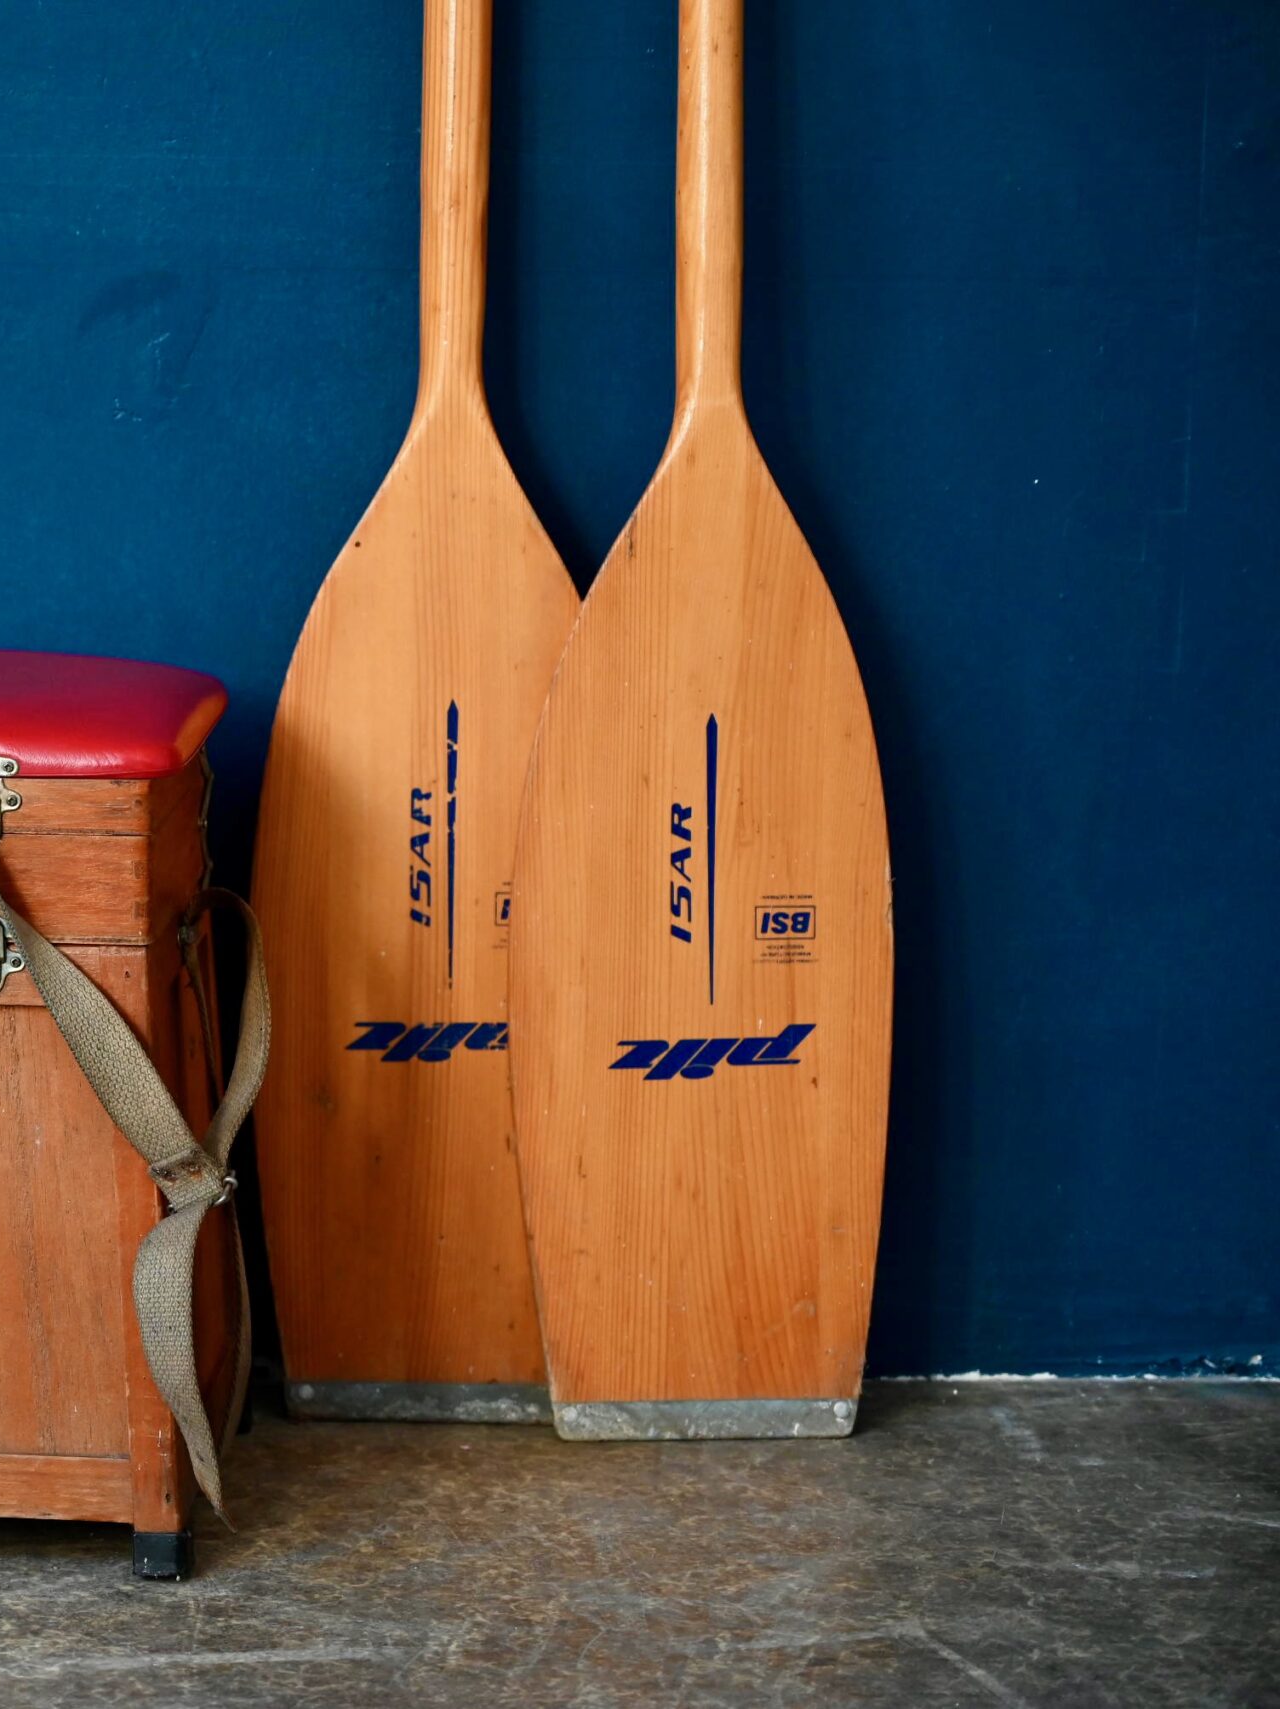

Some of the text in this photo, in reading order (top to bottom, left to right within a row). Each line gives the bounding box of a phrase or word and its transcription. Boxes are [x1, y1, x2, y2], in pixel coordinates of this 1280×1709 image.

[410, 787, 432, 927] ISAR
[670, 802, 693, 943] ISAR
[761, 911, 811, 934] BSI
[608, 1023, 818, 1081] pilz
